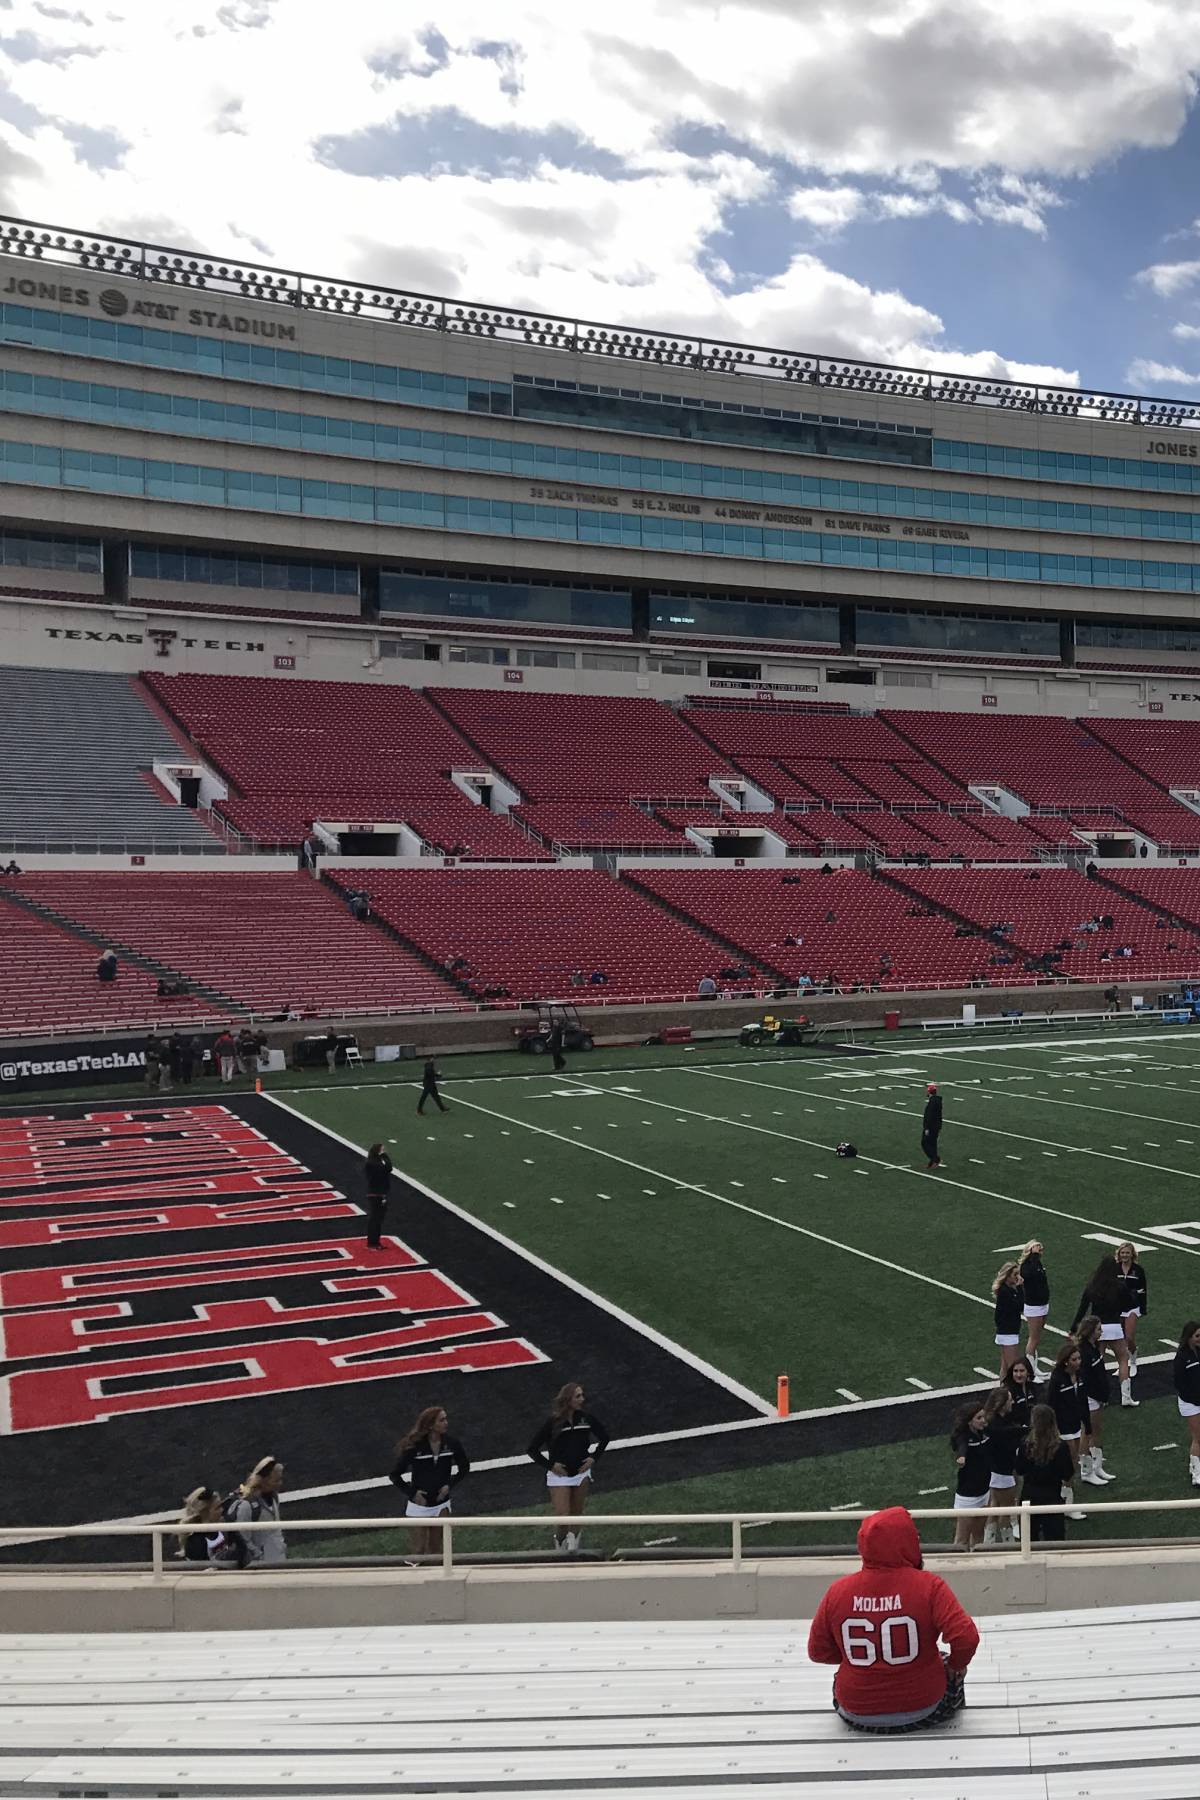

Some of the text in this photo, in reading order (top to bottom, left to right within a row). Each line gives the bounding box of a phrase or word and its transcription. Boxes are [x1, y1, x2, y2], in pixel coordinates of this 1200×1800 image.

[3, 276, 297, 341] JONES AT&T STADIUM
[1146, 441, 1198, 458] JONES
[549, 489, 574, 502] ZACH
[576, 492, 618, 507] THOMAS
[668, 502, 700, 514] HOLUB
[714, 507, 813, 527] 44 DONNY ANDERSON
[839, 520, 861, 532] DAVE
[863, 522, 891, 534] PARKS
[916, 526, 938, 538] GABE
[940, 528, 970, 541] RIVERA
[45, 628, 144, 644] TEXAS
[181, 638, 265, 652] TECH
[277, 657, 293, 666] 103
[853, 1594, 902, 1612] MOLINA
[841, 1615, 919, 1667] 60
